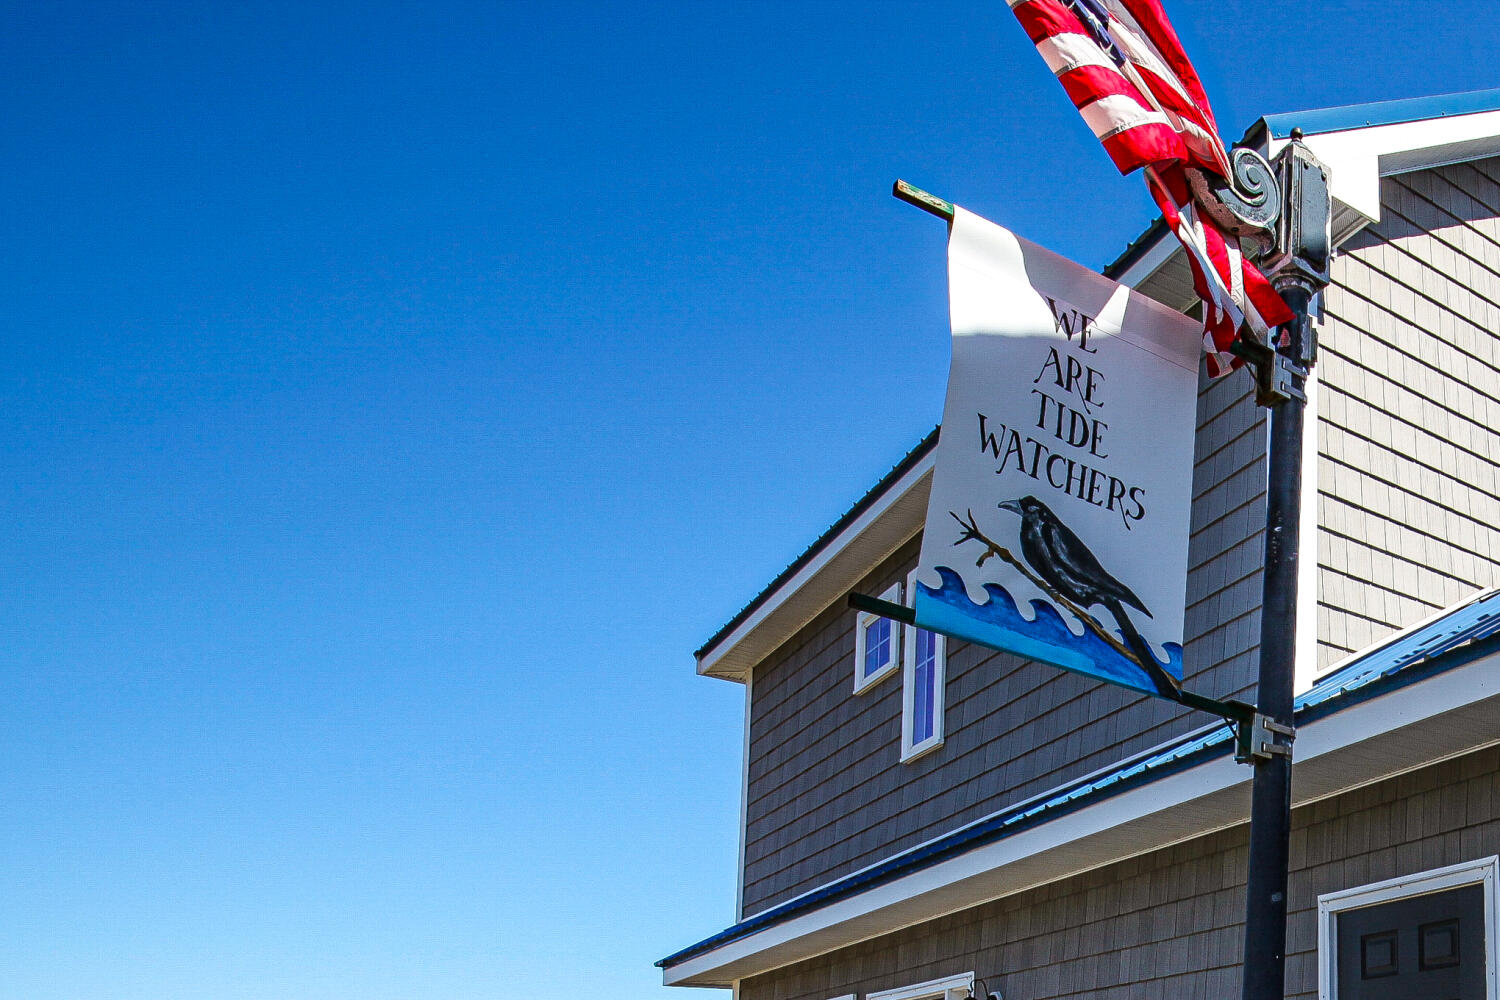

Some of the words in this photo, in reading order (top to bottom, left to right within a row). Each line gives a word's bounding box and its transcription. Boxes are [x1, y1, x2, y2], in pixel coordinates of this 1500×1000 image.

[1045, 295, 1098, 354] WE
[1033, 345, 1106, 415] ARE
[1031, 388, 1109, 460] TIDE
[977, 412, 1146, 531] WATCHERS
